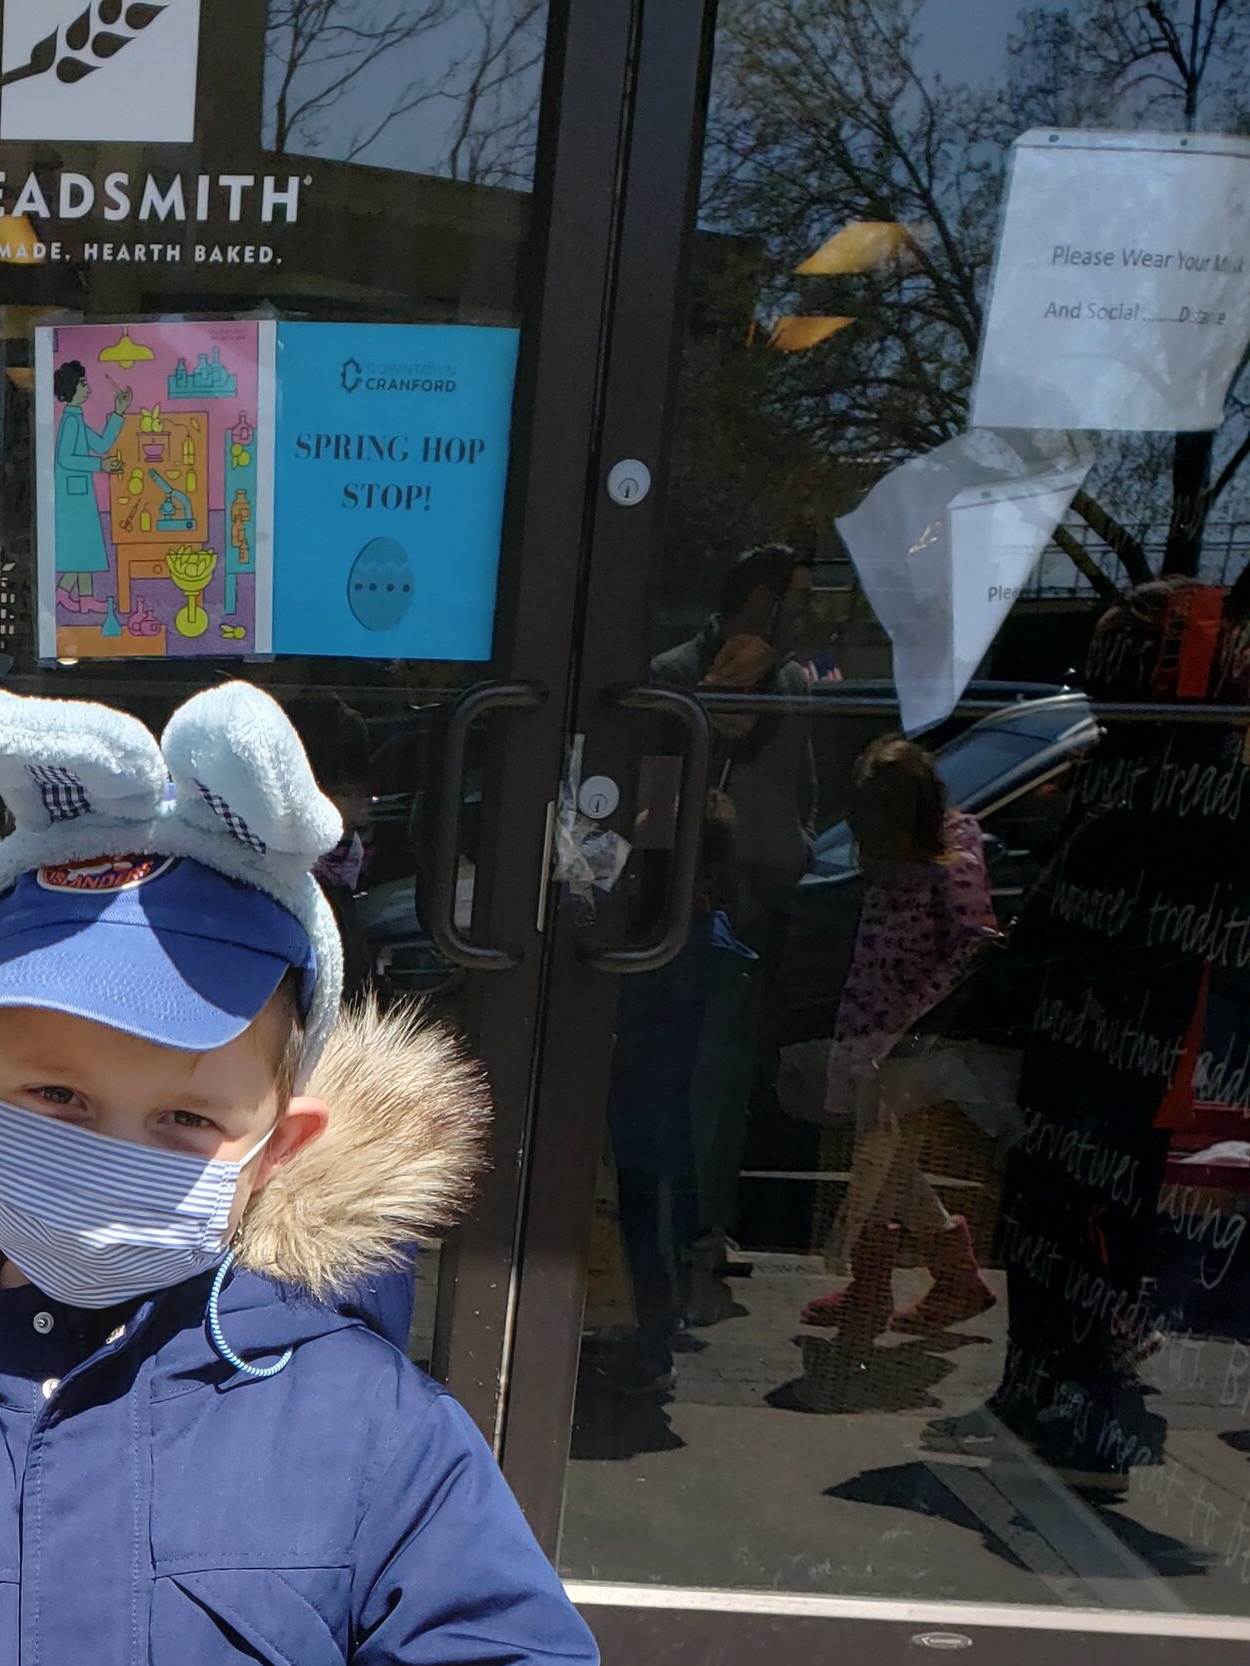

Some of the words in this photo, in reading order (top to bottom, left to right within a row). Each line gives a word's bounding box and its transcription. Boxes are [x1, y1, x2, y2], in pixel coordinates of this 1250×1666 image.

[83, 243, 181, 263] HEARTH
[193, 244, 283, 266] BAKED.
[1051, 244, 1116, 267] Please
[1121, 247, 1173, 269] Wear
[1176, 250, 1212, 273] Your
[1043, 300, 1083, 320] And
[1086, 302, 1141, 321] Social
[365, 378, 457, 393] CRANFORD
[295, 432, 410, 464] SPRING
[421, 435, 487, 465] HOP
[341, 481, 433, 512] STOP!
